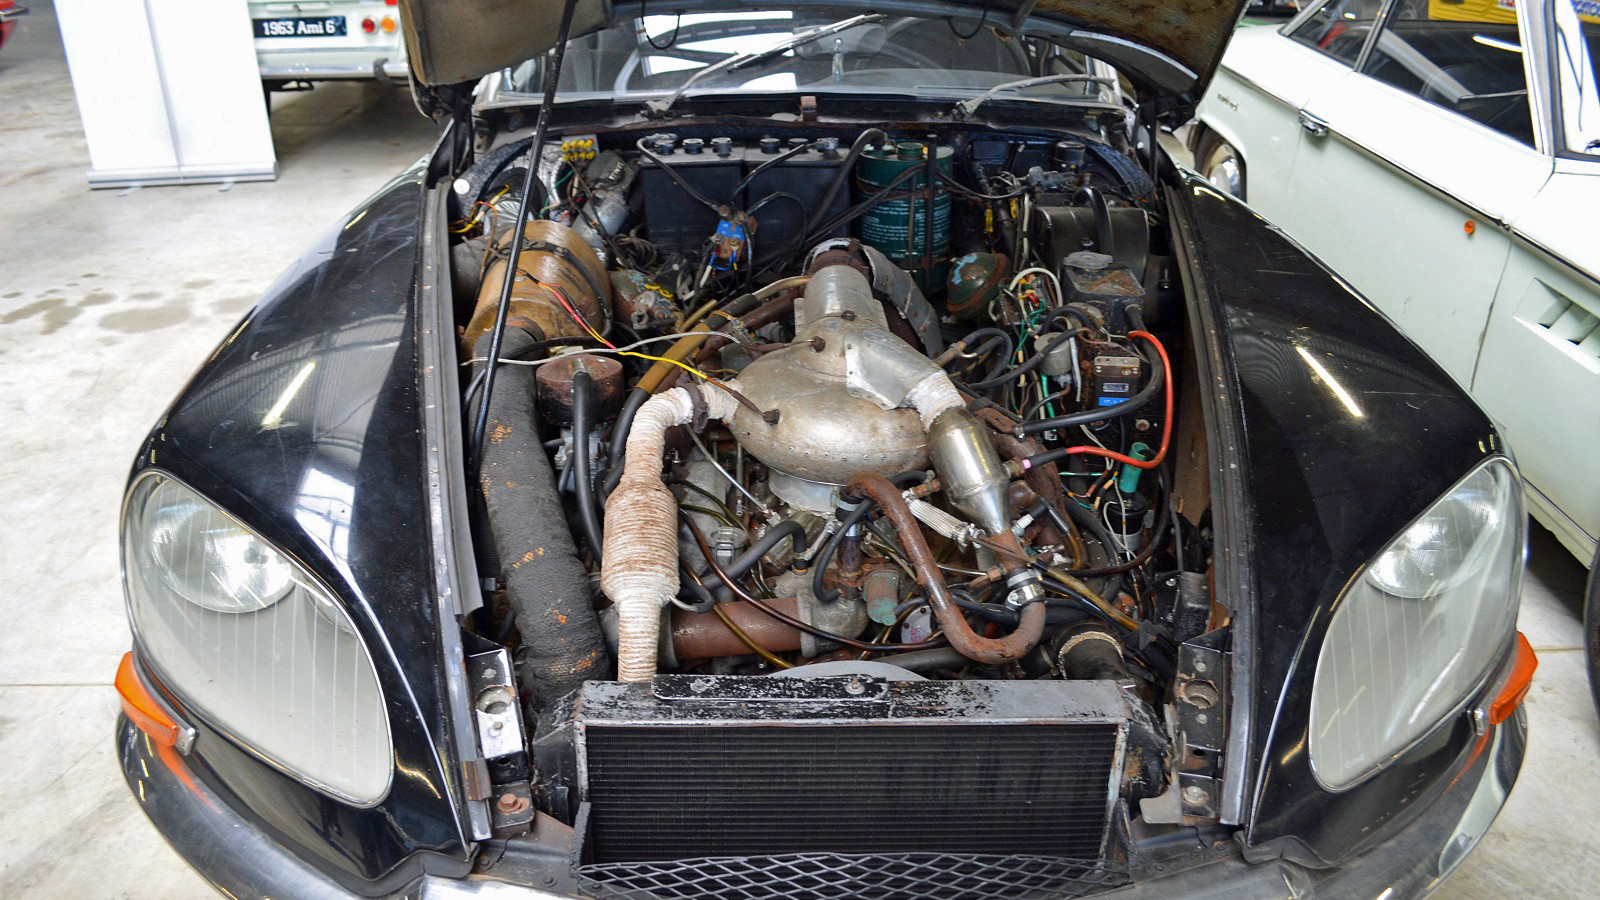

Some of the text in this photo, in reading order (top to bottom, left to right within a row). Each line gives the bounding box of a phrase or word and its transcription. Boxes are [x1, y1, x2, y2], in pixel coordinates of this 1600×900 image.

[262, 19, 336, 35] 1963 Ami 6
